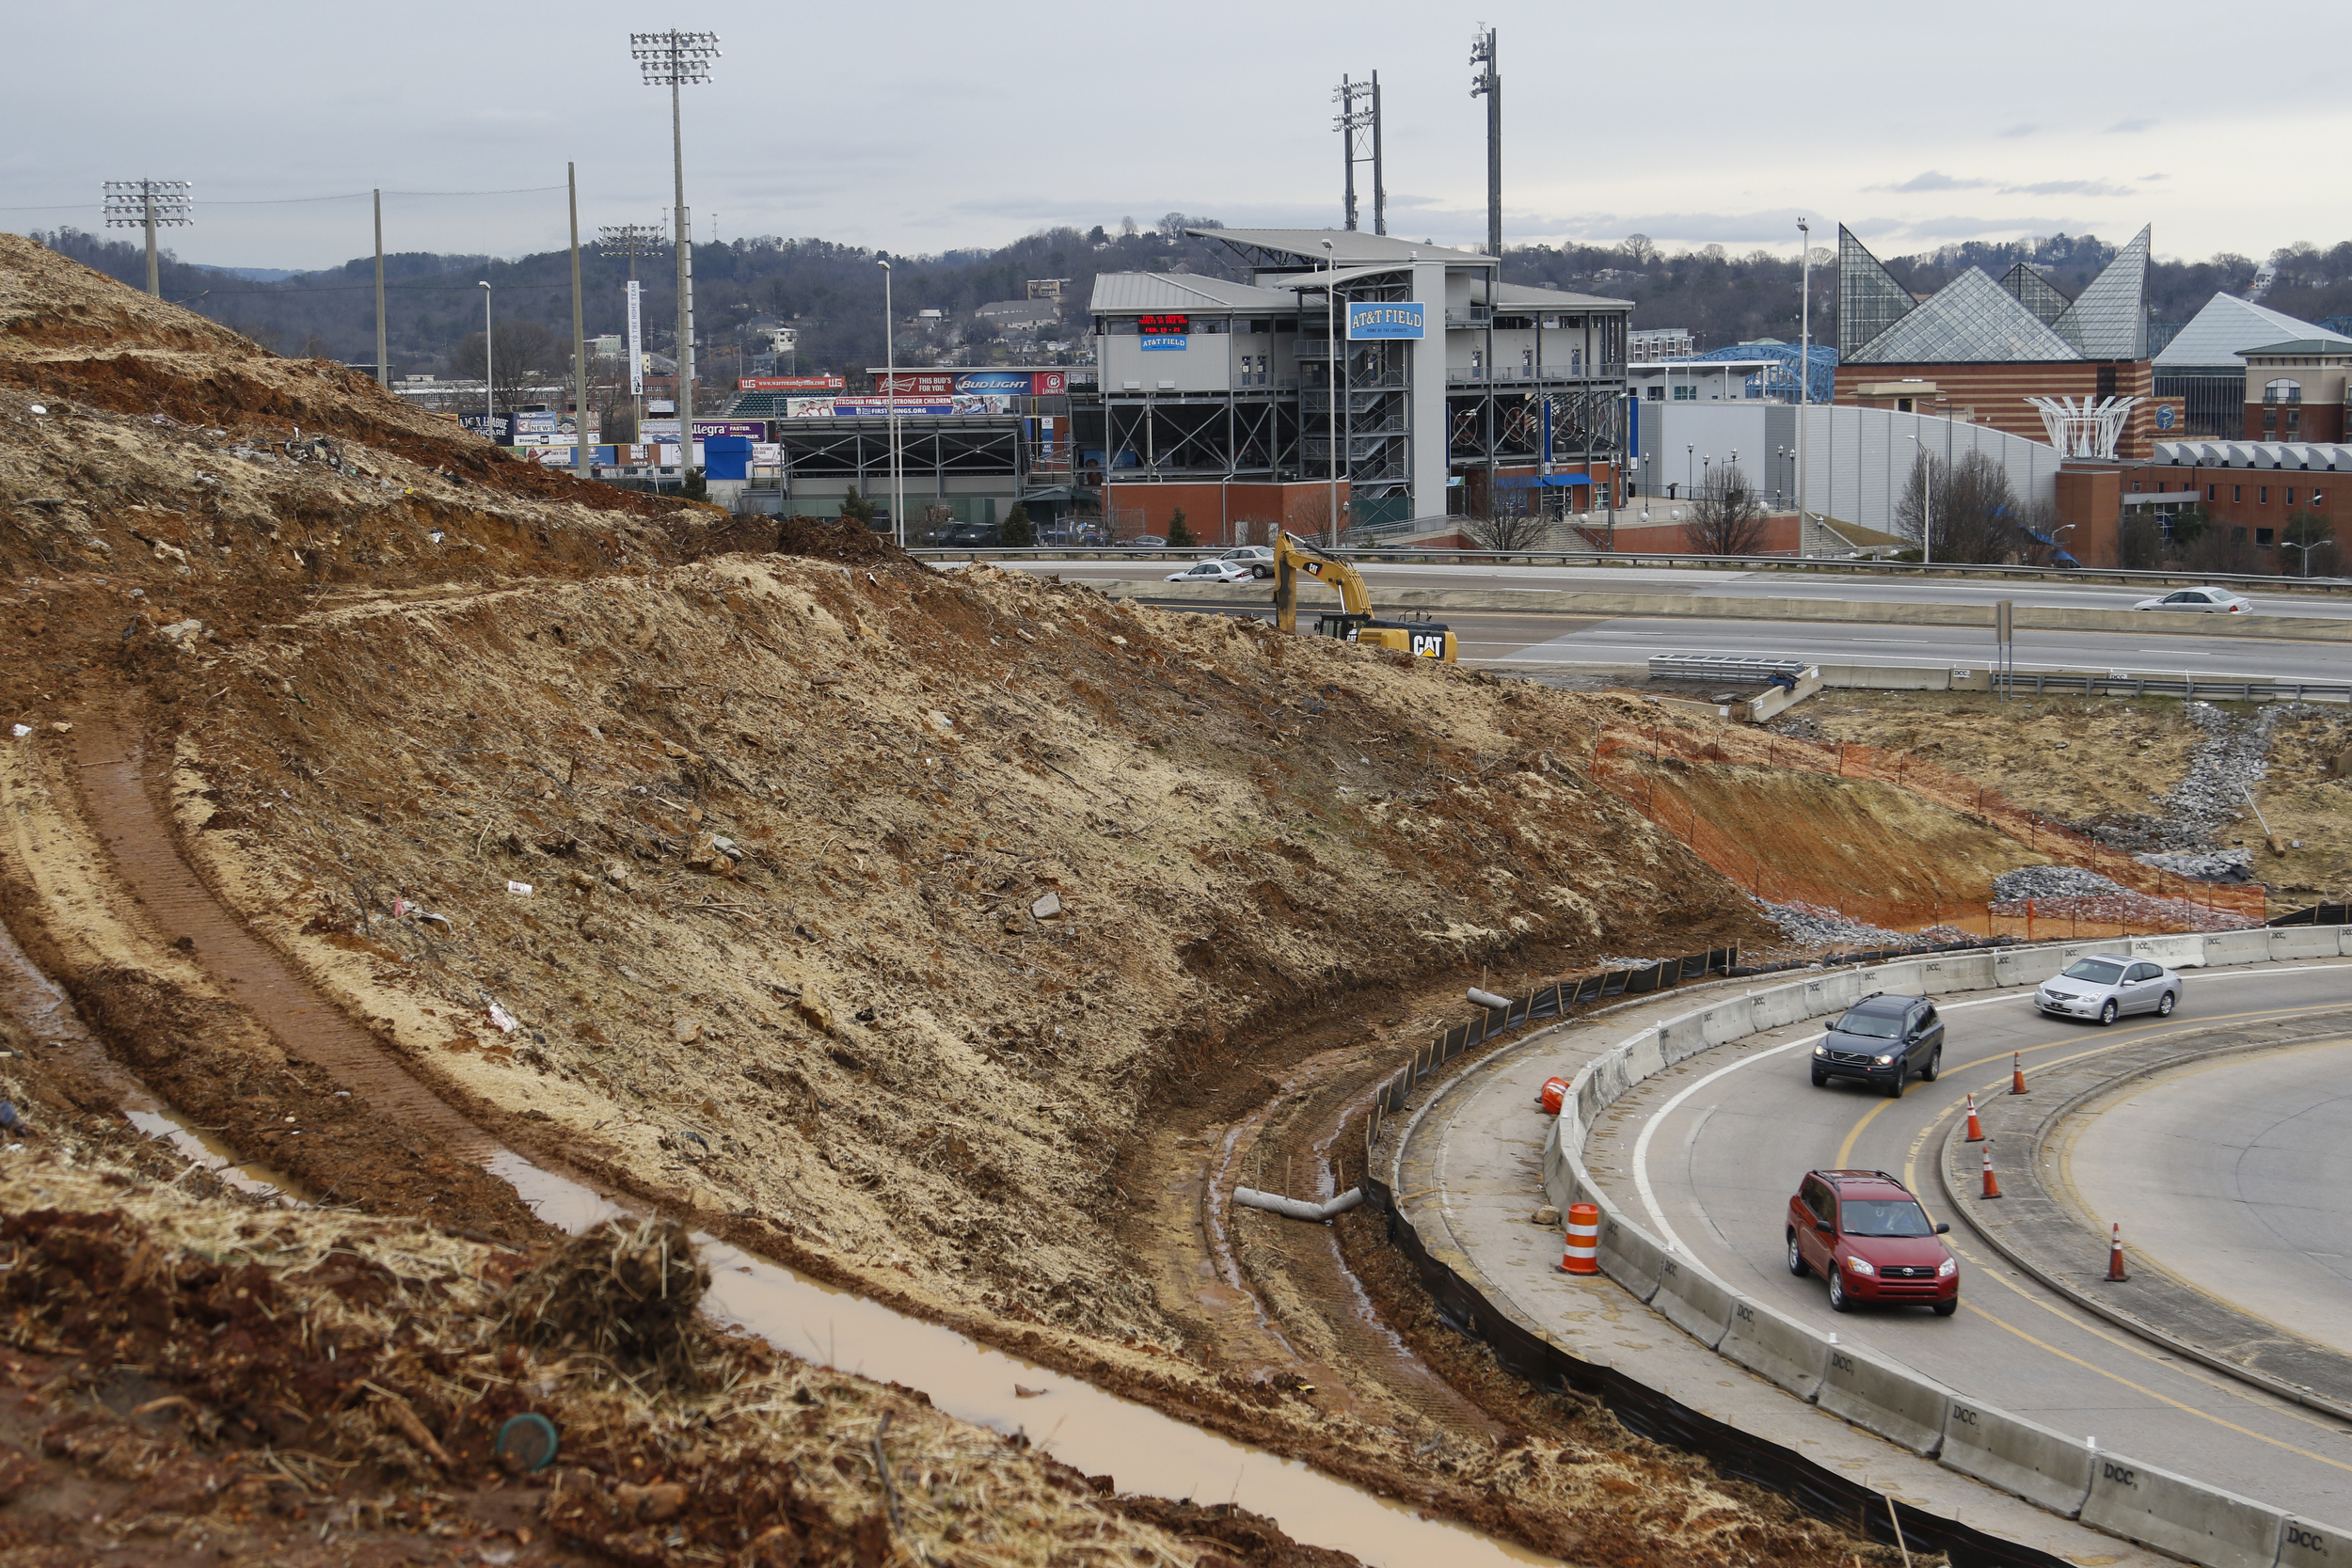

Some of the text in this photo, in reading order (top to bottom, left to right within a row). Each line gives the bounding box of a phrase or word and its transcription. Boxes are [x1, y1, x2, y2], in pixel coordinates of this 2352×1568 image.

[1352, 309, 1422, 329] AT&T FIELD
[632, 335, 638, 343] TO
[1143, 339, 1161, 347] AT&T
[519, 421, 529, 431] 3
[692, 424, 725, 436] llegra
[1309, 563, 1318, 575] CAT
[1414, 635, 1442, 657] CAT
[1865, 972, 1875, 981] DCC
[1665, 1260, 1677, 1276] DCC
[1737, 1303, 1754, 1322] DCC
[1832, 1352, 1852, 1372] DCC
[1953, 1404, 1976, 1425] DCC
[2103, 1462, 2134, 1485] DCC
[2287, 1526, 2323, 1551] DCC
